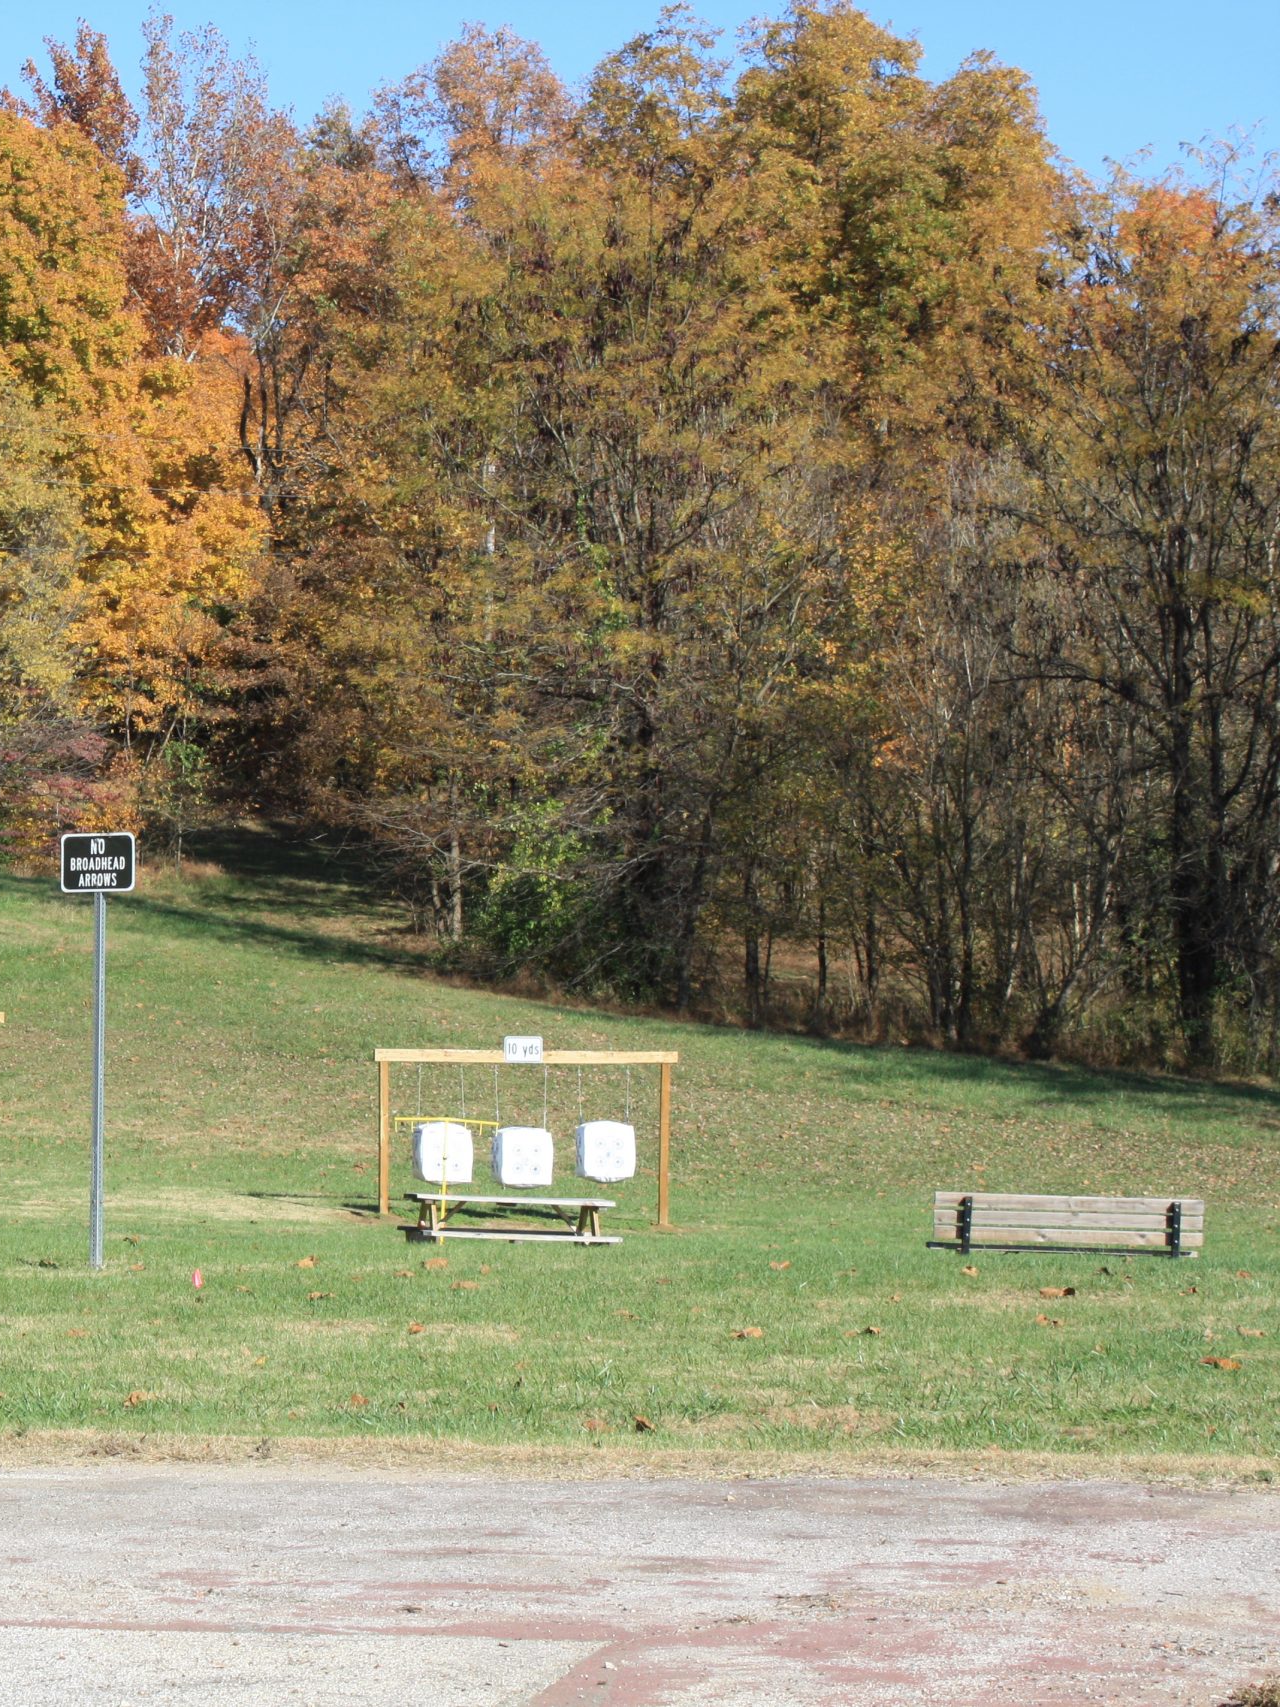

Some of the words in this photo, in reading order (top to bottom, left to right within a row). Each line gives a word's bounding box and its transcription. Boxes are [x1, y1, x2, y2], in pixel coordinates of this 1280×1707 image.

[90, 838, 105, 855] NO
[70, 856, 126, 871] BROADHEAD
[78, 873, 117, 887] ARROWS
[508, 1042, 518, 1055] 10
[522, 1043, 540, 1058] yds
